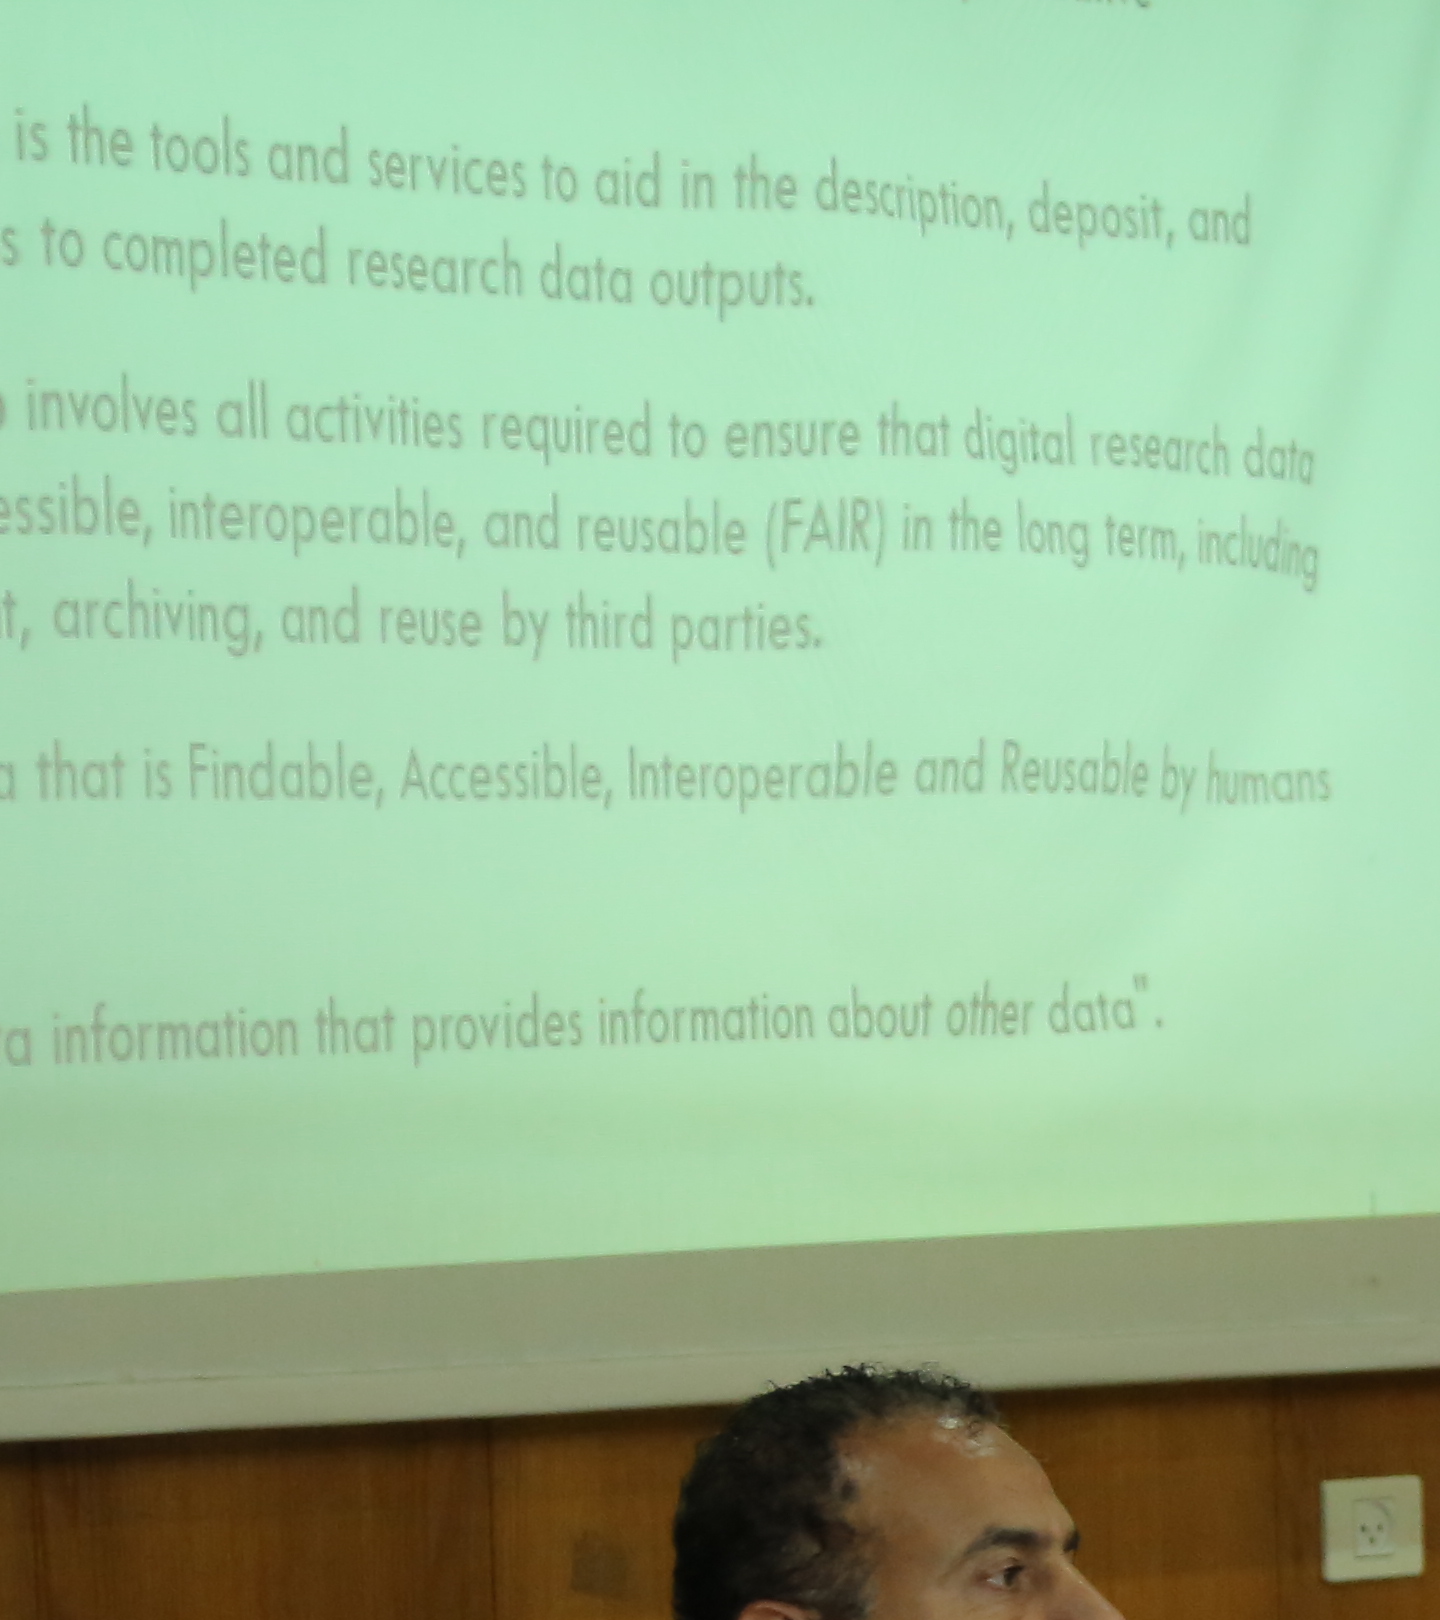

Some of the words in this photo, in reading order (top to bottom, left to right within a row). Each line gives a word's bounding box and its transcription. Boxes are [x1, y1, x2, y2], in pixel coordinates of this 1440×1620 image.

[15, 107, 50, 163] is
[66, 103, 135, 169] the
[149, 114, 252, 178] tools
[268, 124, 350, 185] and
[368, 144, 527, 199] services
[540, 155, 579, 204] to
[594, 150, 662, 209] aid
[681, 159, 716, 209] in
[733, 152, 798, 211] the
[814, 155, 1015, 242] description,
[1028, 179, 1175, 250] deposit,
[1188, 192, 1252, 247] and
[40, 217, 86, 269] to
[102, 217, 328, 293] completed
[348, 238, 524, 297] research
[539, 242, 634, 304] data
[650, 261, 815, 323] outputs.
[26, 372, 198, 438] involves
[216, 378, 269, 439] all
[286, 392, 464, 450] activities
[482, 399, 653, 466] required
[668, 412, 708, 459] to
[724, 419, 861, 459] ensure
[877, 400, 951, 457] that
[963, 406, 1076, 477] digital
[1090, 423, 1230, 476] research
[1244, 427, 1317, 487] data
[169, 487, 467, 559] interoperable,
[483, 492, 560, 550] and
[578, 498, 748, 556] reusable
[765, 497, 886, 570] (FAIR)
[902, 503, 934, 551] in
[948, 497, 1004, 553] the
[1017, 499, 1091, 570] long
[1104, 515, 1187, 571] term,
[1198, 515, 1321, 595] including
[53, 578, 264, 659] archiving,
[281, 584, 361, 644] and
[380, 606, 484, 648] reuse
[502, 589, 550, 662] by
[565, 590, 655, 650] third
[671, 603, 824, 664] parties.
[35, 739, 127, 801] that
[144, 747, 173, 800] is
[189, 740, 385, 810] Findable,
[400, 741, 613, 810] Accessible,
[628, 739, 899, 814] Interoperable
[914, 737, 987, 794] and
[1001, 739, 1150, 798] Reusable
[1160, 743, 1198, 815] by
[1206, 749, 1332, 805] humans
[53, 1001, 298, 1063] information
[315, 995, 396, 1055] that
[413, 991, 584, 1066] provides
[599, 987, 815, 1045] information
[828, 985, 934, 1039] about
[945, 980, 1035, 1038] other
